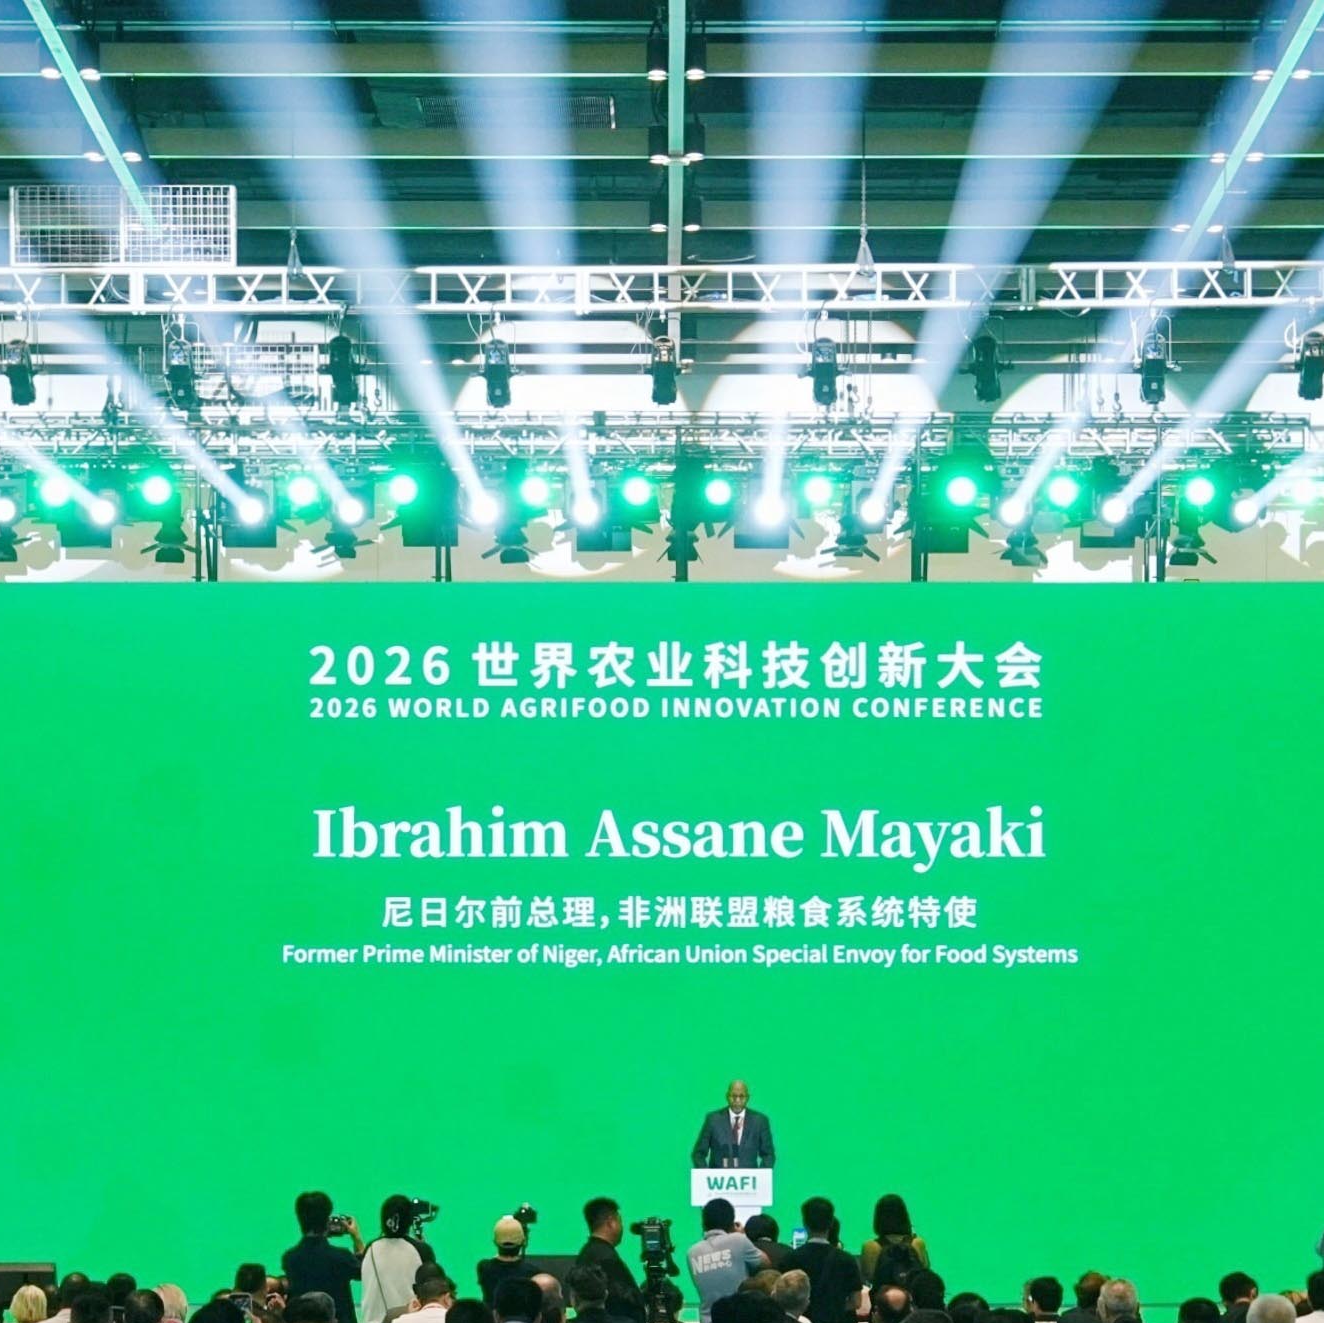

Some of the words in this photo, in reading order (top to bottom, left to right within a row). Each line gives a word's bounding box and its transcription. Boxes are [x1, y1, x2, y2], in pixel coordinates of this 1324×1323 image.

[309, 644, 451, 687] 2026
[471, 640, 1043, 690] 世界农业科技创新大会
[310, 697, 377, 719] 2026
[388, 697, 490, 719] WORLD
[500, 697, 650, 719] AGRIFOOD
[661, 697, 841, 719] INNOVATION
[852, 697, 1043, 719] CONFERENCE
[312, 804, 569, 859] Ibrahim
[585, 808, 804, 859] Assane
[820, 804, 1047, 874] Mayaki
[282, 944, 359, 964] Former
[362, 943, 425, 964] Prime
[429, 943, 513, 964] Minister
[516, 943, 539, 964] of
[542, 943, 603, 969] Niger,
[606, 943, 681, 964] African
[685, 943, 748, 964] Union
[752, 943, 828, 968] Special
[832, 944, 897, 968] Envoy
[900, 943, 932, 964] for
[935, 943, 987, 964] Food
[992, 944, 1079, 968] Systems
[706, 1176, 758, 1191] WAFI
[691, 1248, 732, 1275] NEWS
